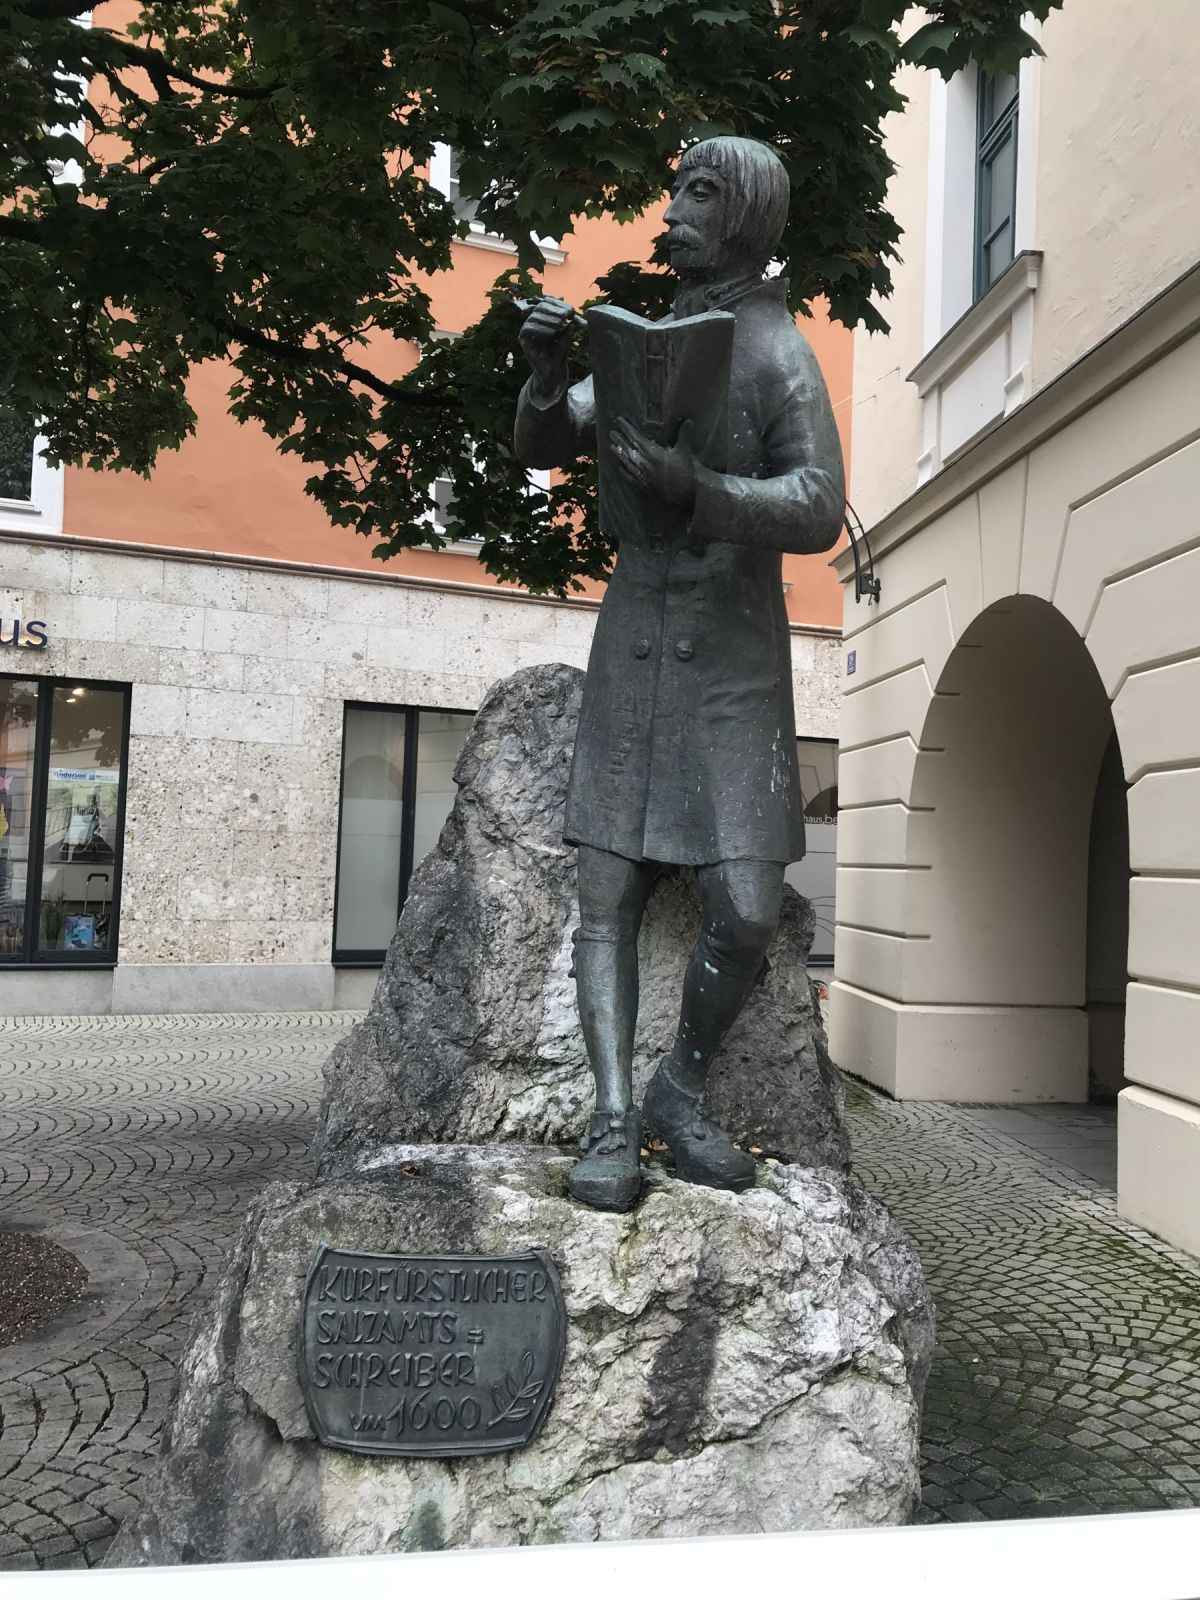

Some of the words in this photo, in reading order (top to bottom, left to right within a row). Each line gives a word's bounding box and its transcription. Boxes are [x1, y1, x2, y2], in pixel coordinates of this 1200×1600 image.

[319, 1261, 548, 1302] KURFÜRSTLICHER
[314, 1352, 475, 1389] SCHREIBER
[386, 1391, 481, 1436] 1600
